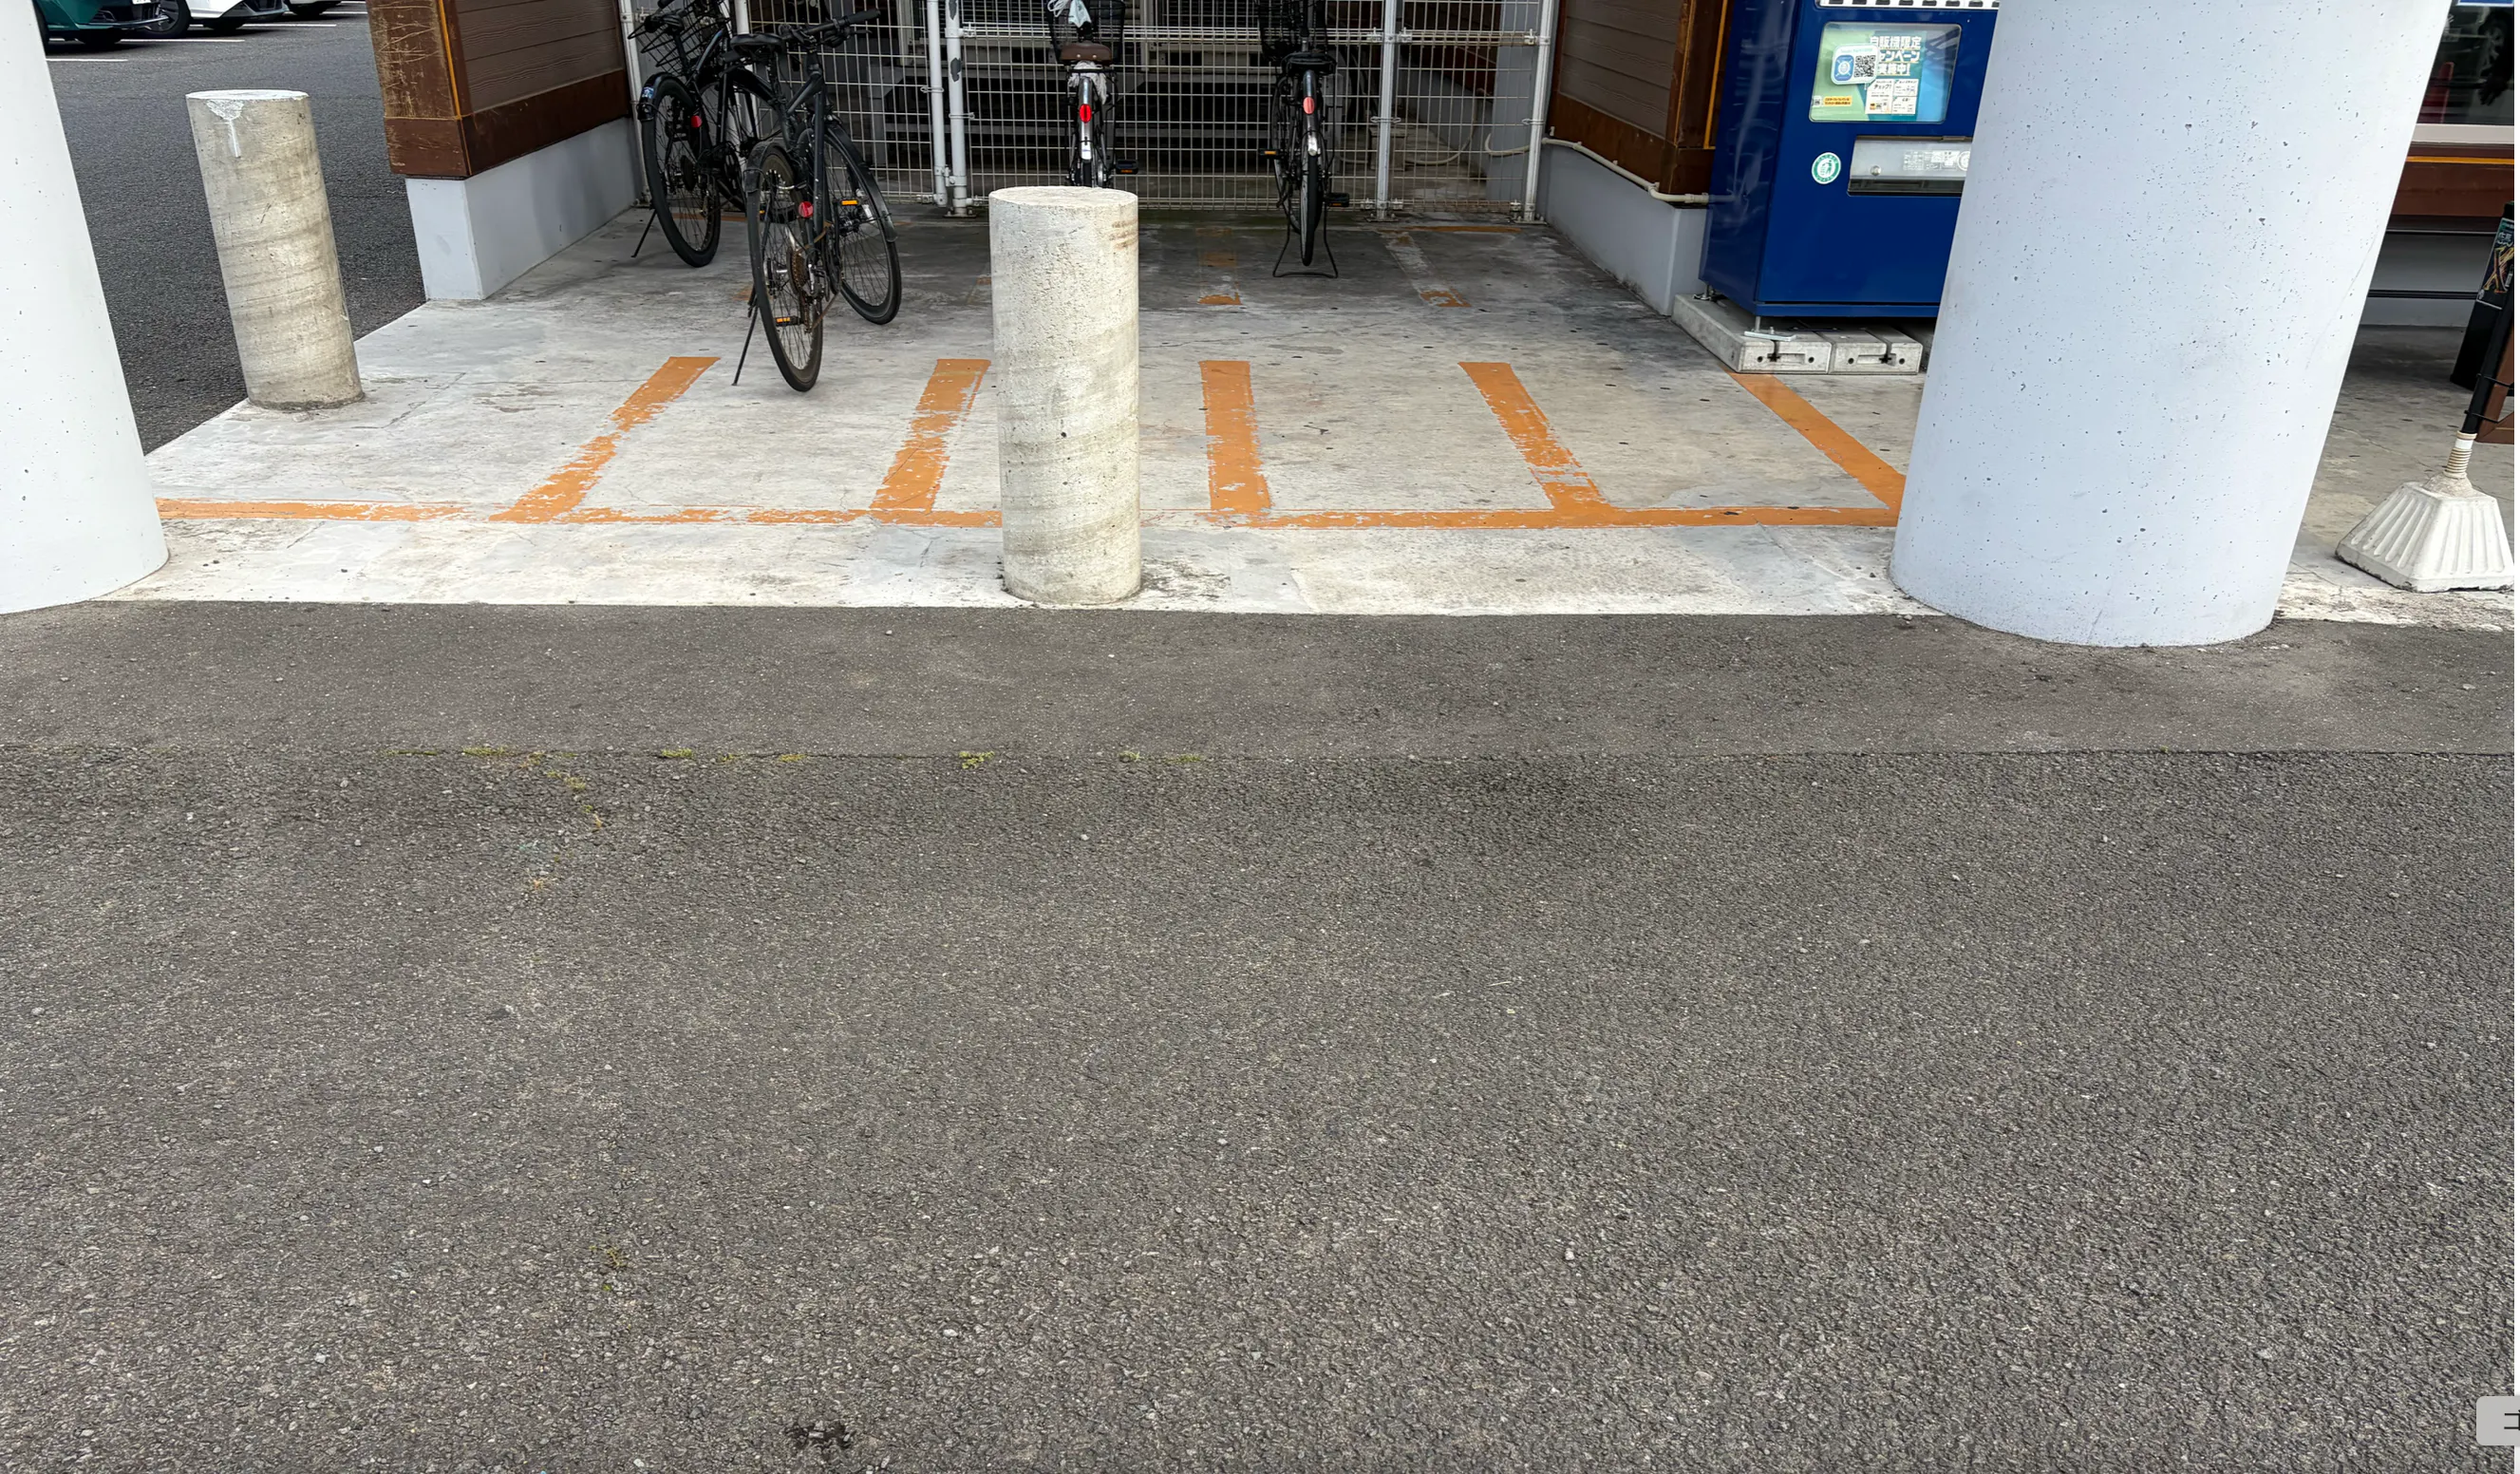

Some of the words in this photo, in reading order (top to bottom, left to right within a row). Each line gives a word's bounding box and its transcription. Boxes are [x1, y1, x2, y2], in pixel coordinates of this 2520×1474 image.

[1878, 50, 1921, 63] ャンペーン
